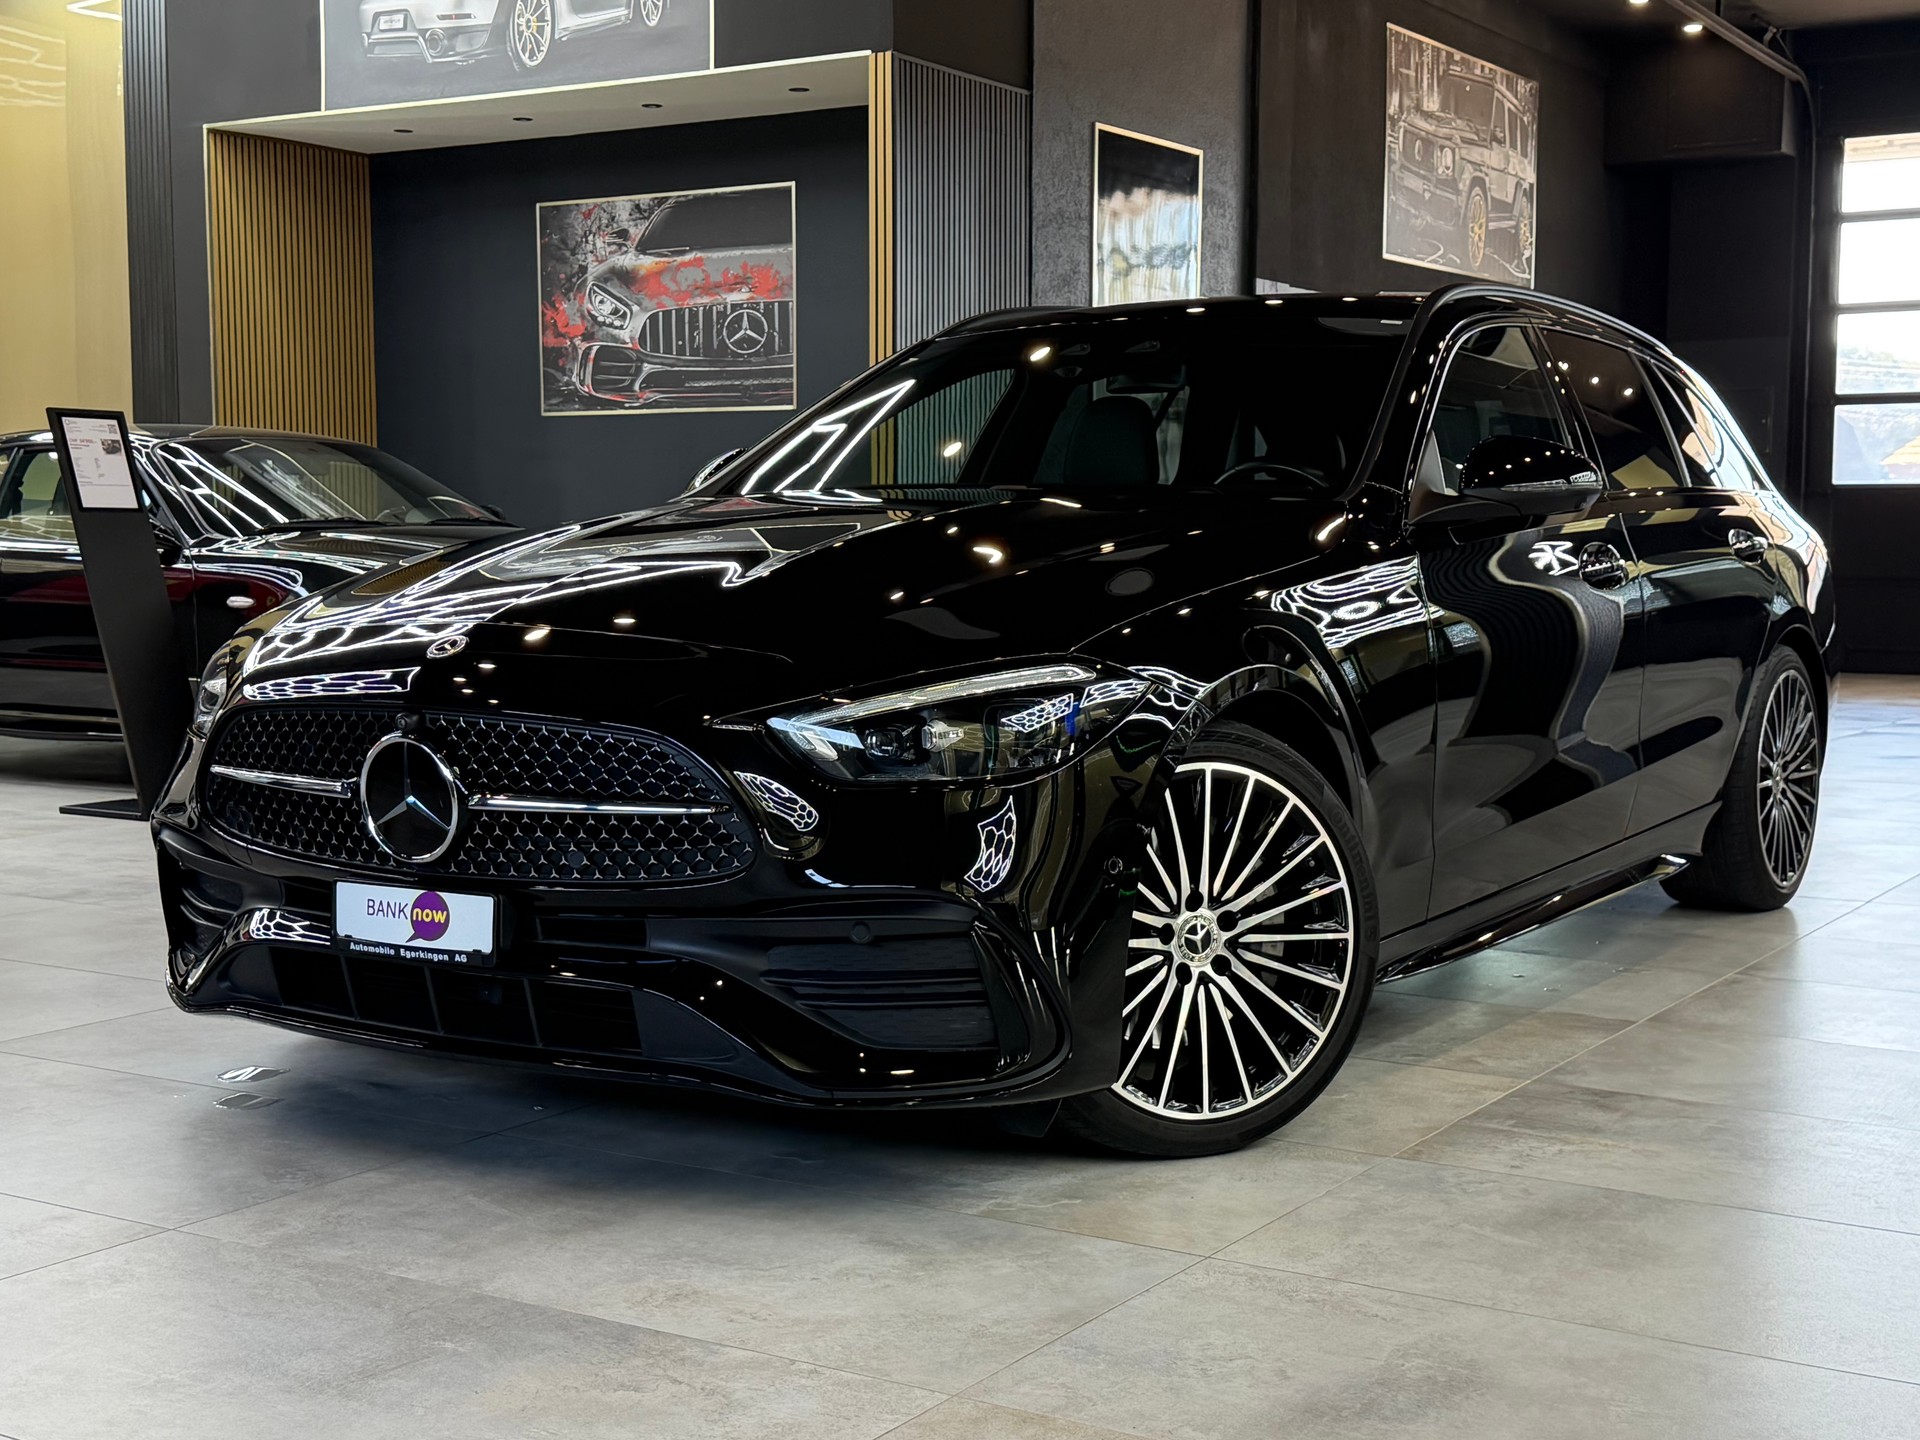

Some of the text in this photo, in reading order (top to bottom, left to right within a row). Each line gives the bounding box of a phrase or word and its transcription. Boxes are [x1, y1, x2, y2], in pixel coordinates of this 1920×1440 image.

[367, 899, 447, 923] BANK now
[350, 942, 467, 963] Automobile Egerkingen AG
